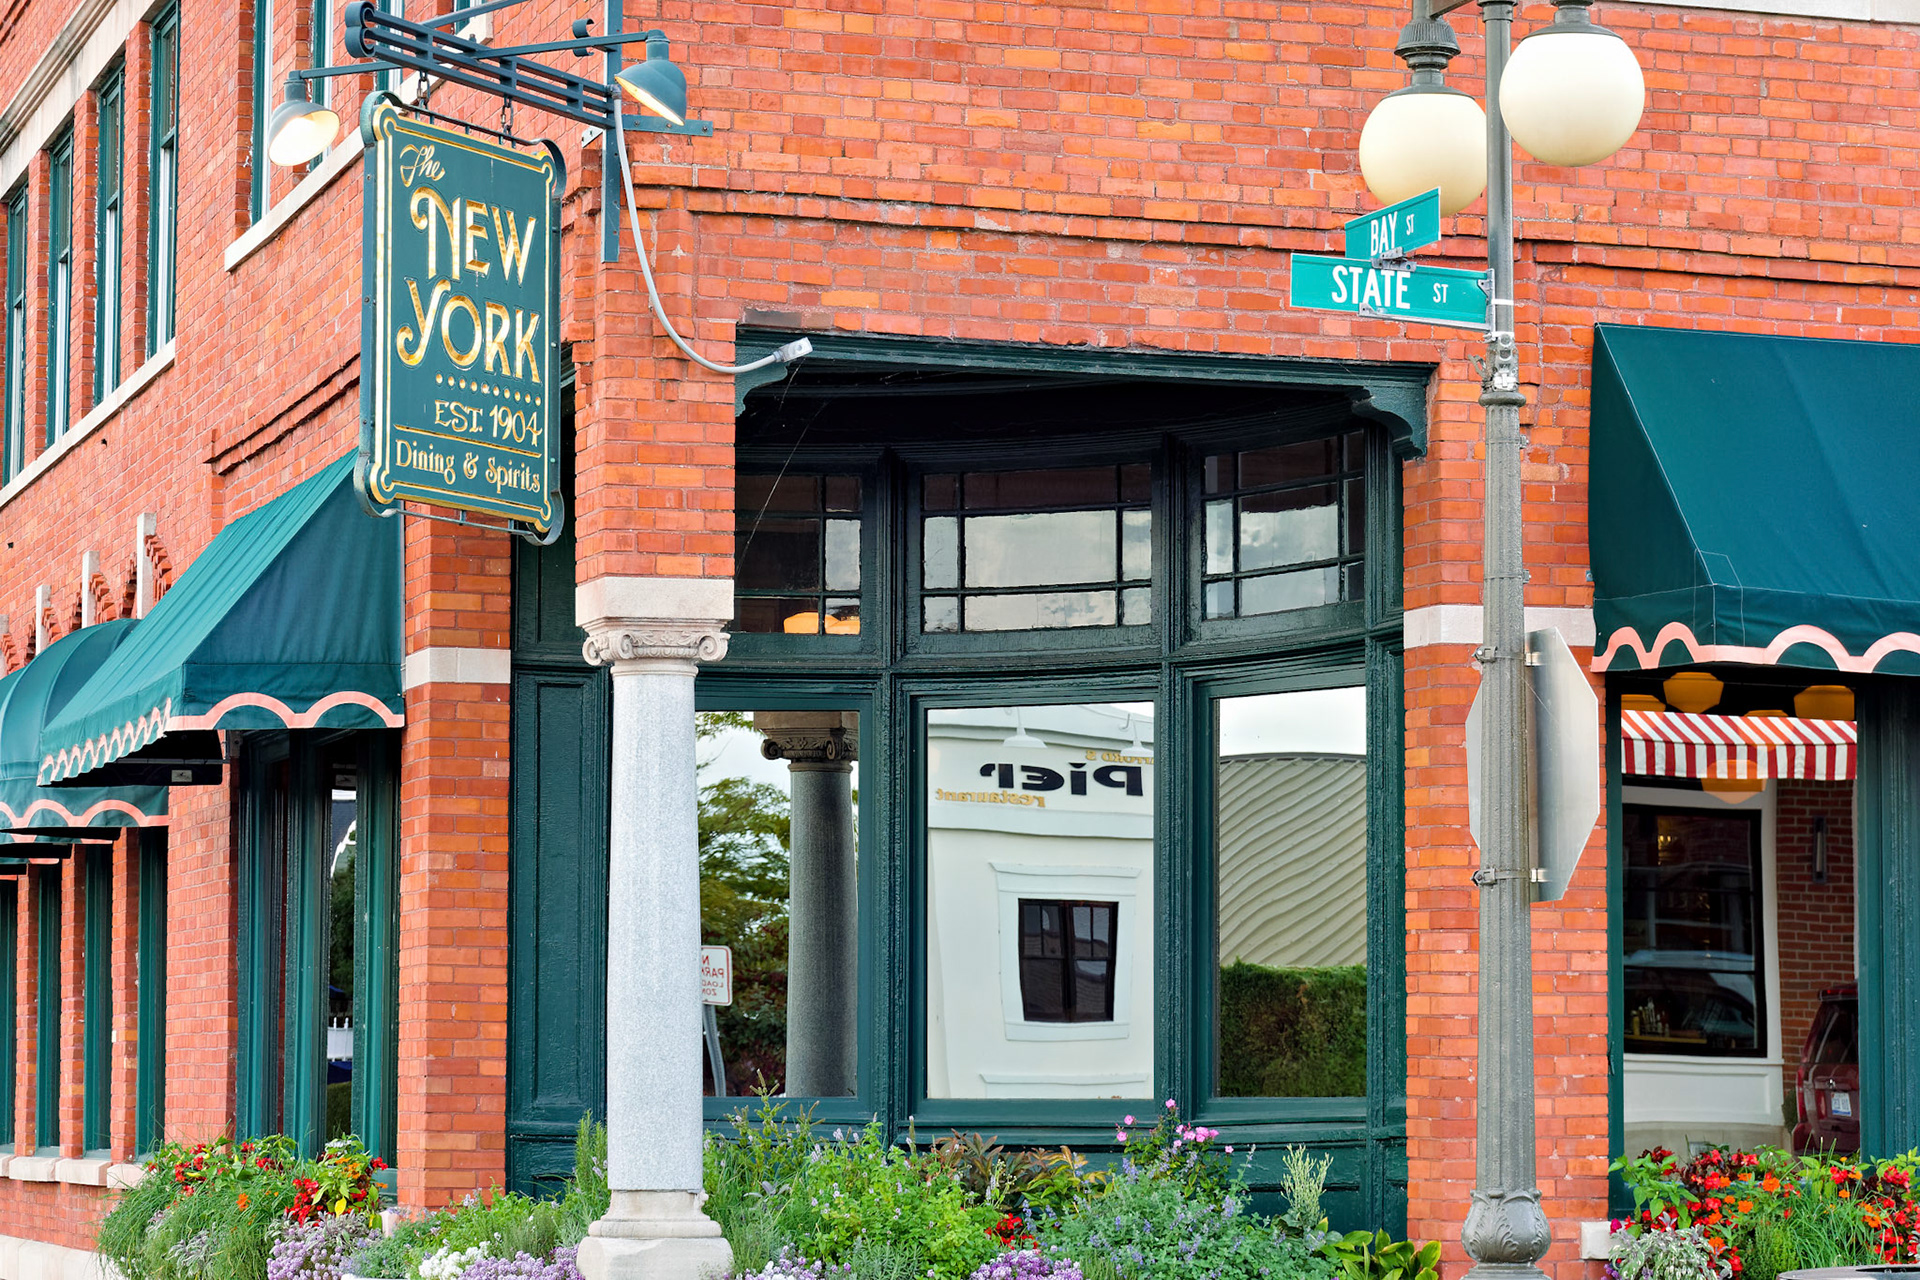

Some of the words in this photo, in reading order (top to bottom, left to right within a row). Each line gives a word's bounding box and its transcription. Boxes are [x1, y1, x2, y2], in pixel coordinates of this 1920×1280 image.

[400, 144, 446, 188] The
[410, 186, 536, 286] NEW
[1370, 211, 1398, 256] BAY
[1406, 213, 1415, 236] ST
[1331, 265, 1411, 309] STATE
[1432, 282, 1448, 303] ST
[396, 279, 541, 383] YORK
[434, 399, 483, 433] EST.
[489, 404, 543, 447] 1904
[395, 439, 456, 485] Dining
[463, 452, 479, 479] &
[485, 456, 541, 494] Spirits
